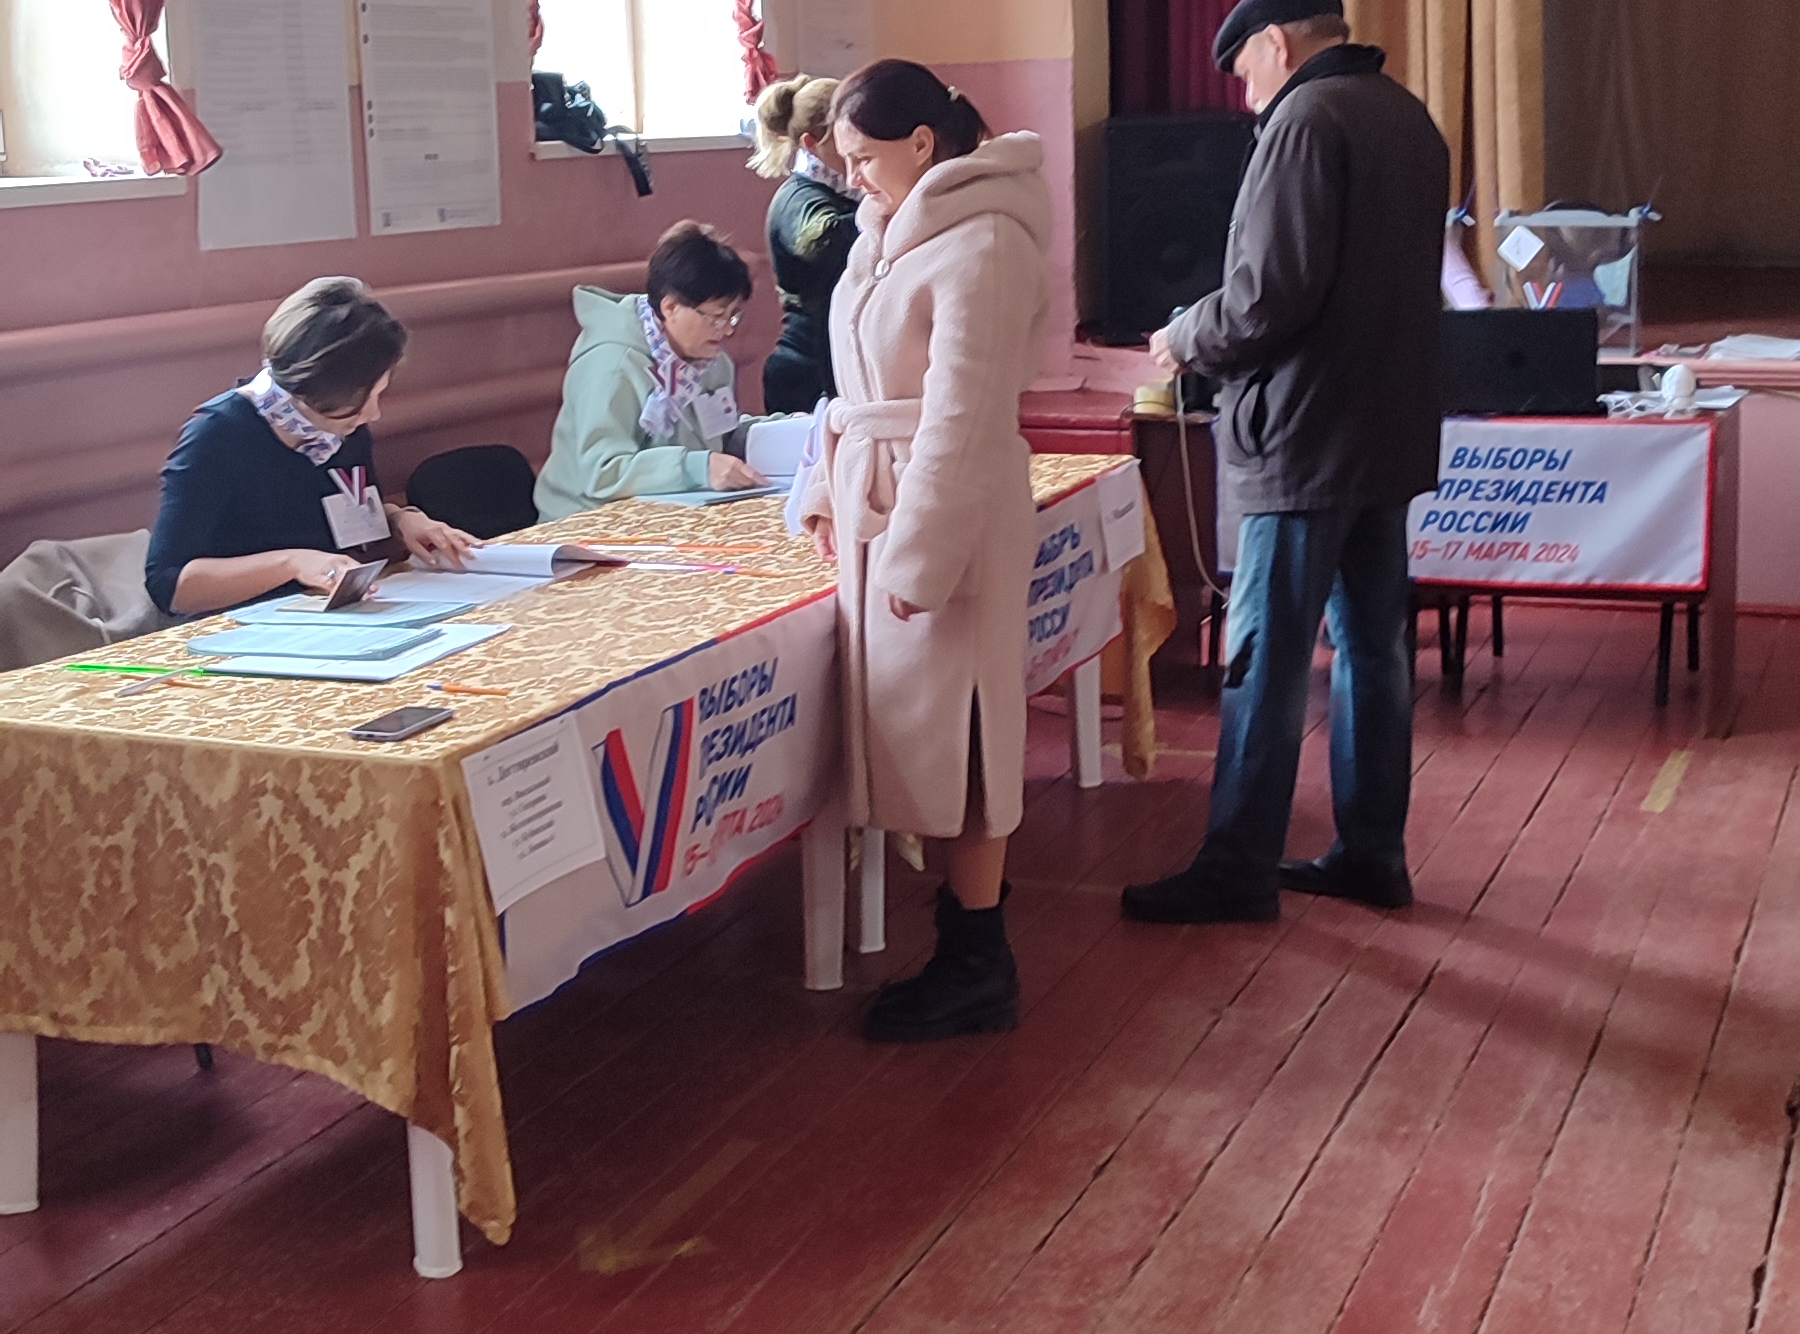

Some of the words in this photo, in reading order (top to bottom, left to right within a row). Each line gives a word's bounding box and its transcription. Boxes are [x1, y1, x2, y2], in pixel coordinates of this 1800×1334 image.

[1448, 446, 1573, 471] ВЫБОРЫ
[1433, 478, 1609, 506] ПРЕЗИДЕНТА
[1418, 510, 1532, 534] РОССИИ
[1463, 541, 1531, 562] МАРТА
[1531, 543, 1580, 563] 2024
[698, 657, 778, 725] ВЫБОРЫ
